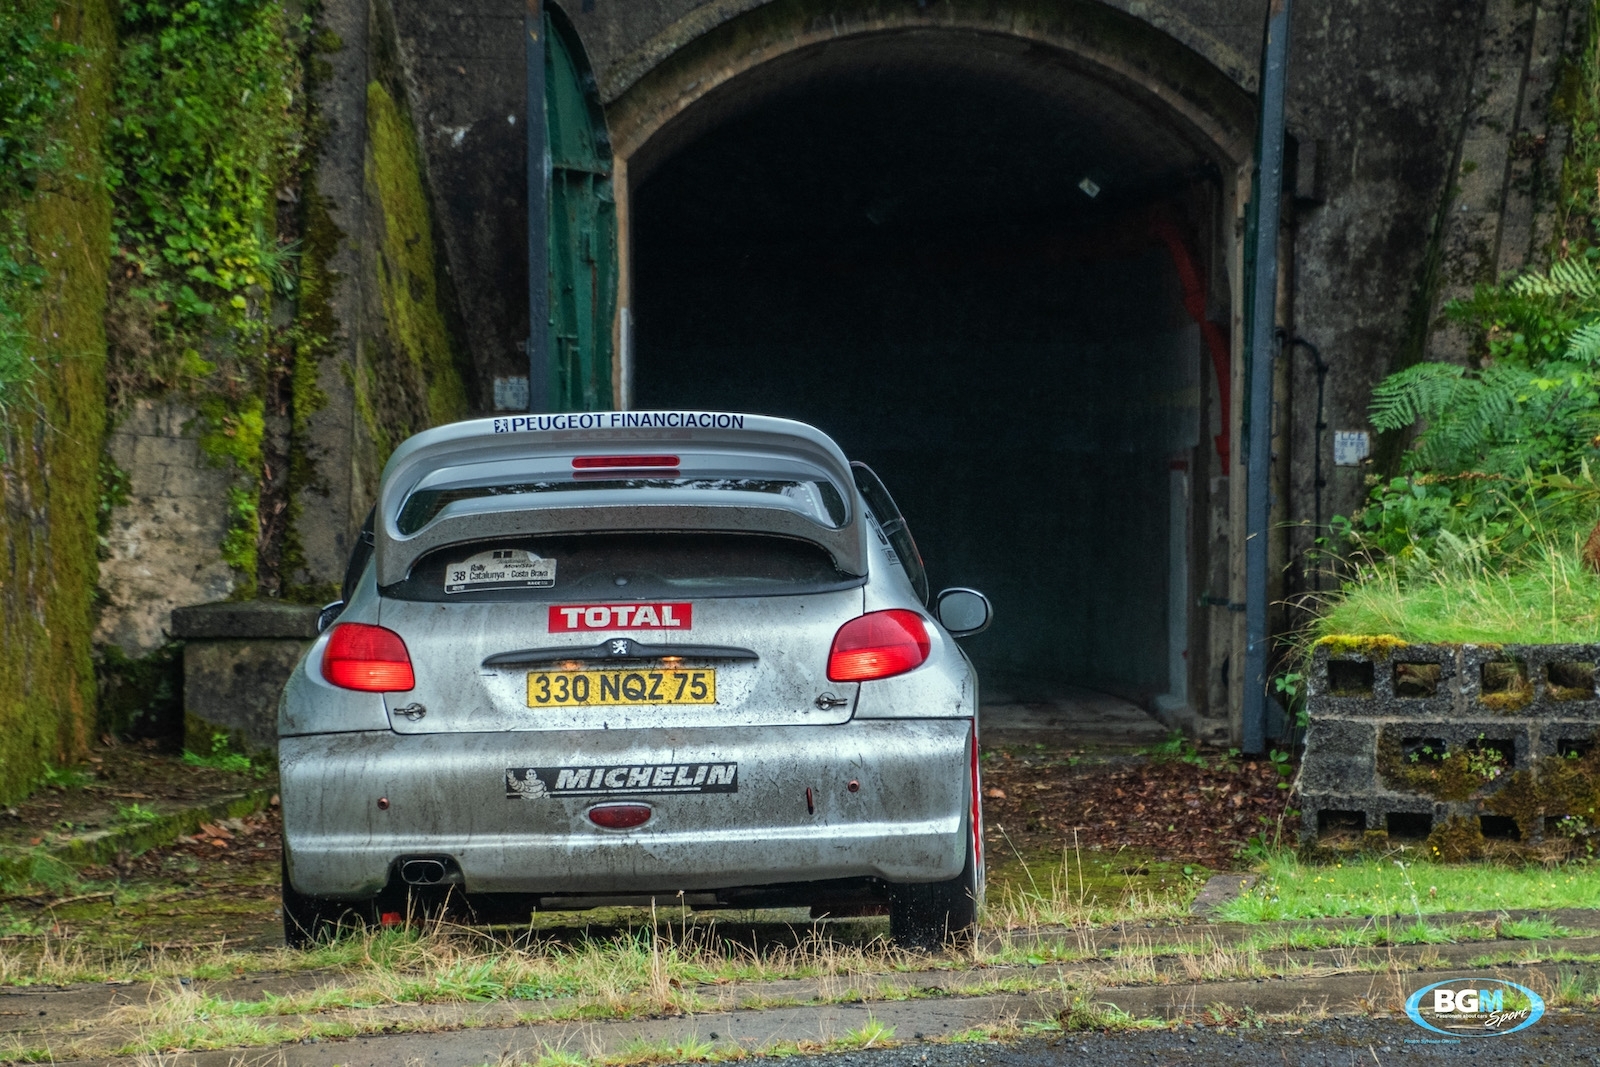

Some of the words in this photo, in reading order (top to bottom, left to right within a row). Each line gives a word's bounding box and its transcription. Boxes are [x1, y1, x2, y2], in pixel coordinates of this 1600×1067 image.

[512, 414, 605, 432] PEUGEOT
[611, 412, 744, 429] FINANCIACION
[452, 571, 466, 582] 38
[469, 571, 505, 581] Catalunya
[511, 570, 529, 578] Costa
[530, 569, 549, 578] Brava
[470, 564, 486, 572] Rally
[560, 605, 681, 629] TOTAL
[535, 674, 590, 703] 330
[600, 673, 664, 701] NQZ
[673, 672, 708, 700] 75
[554, 764, 738, 789] MICHELIN
